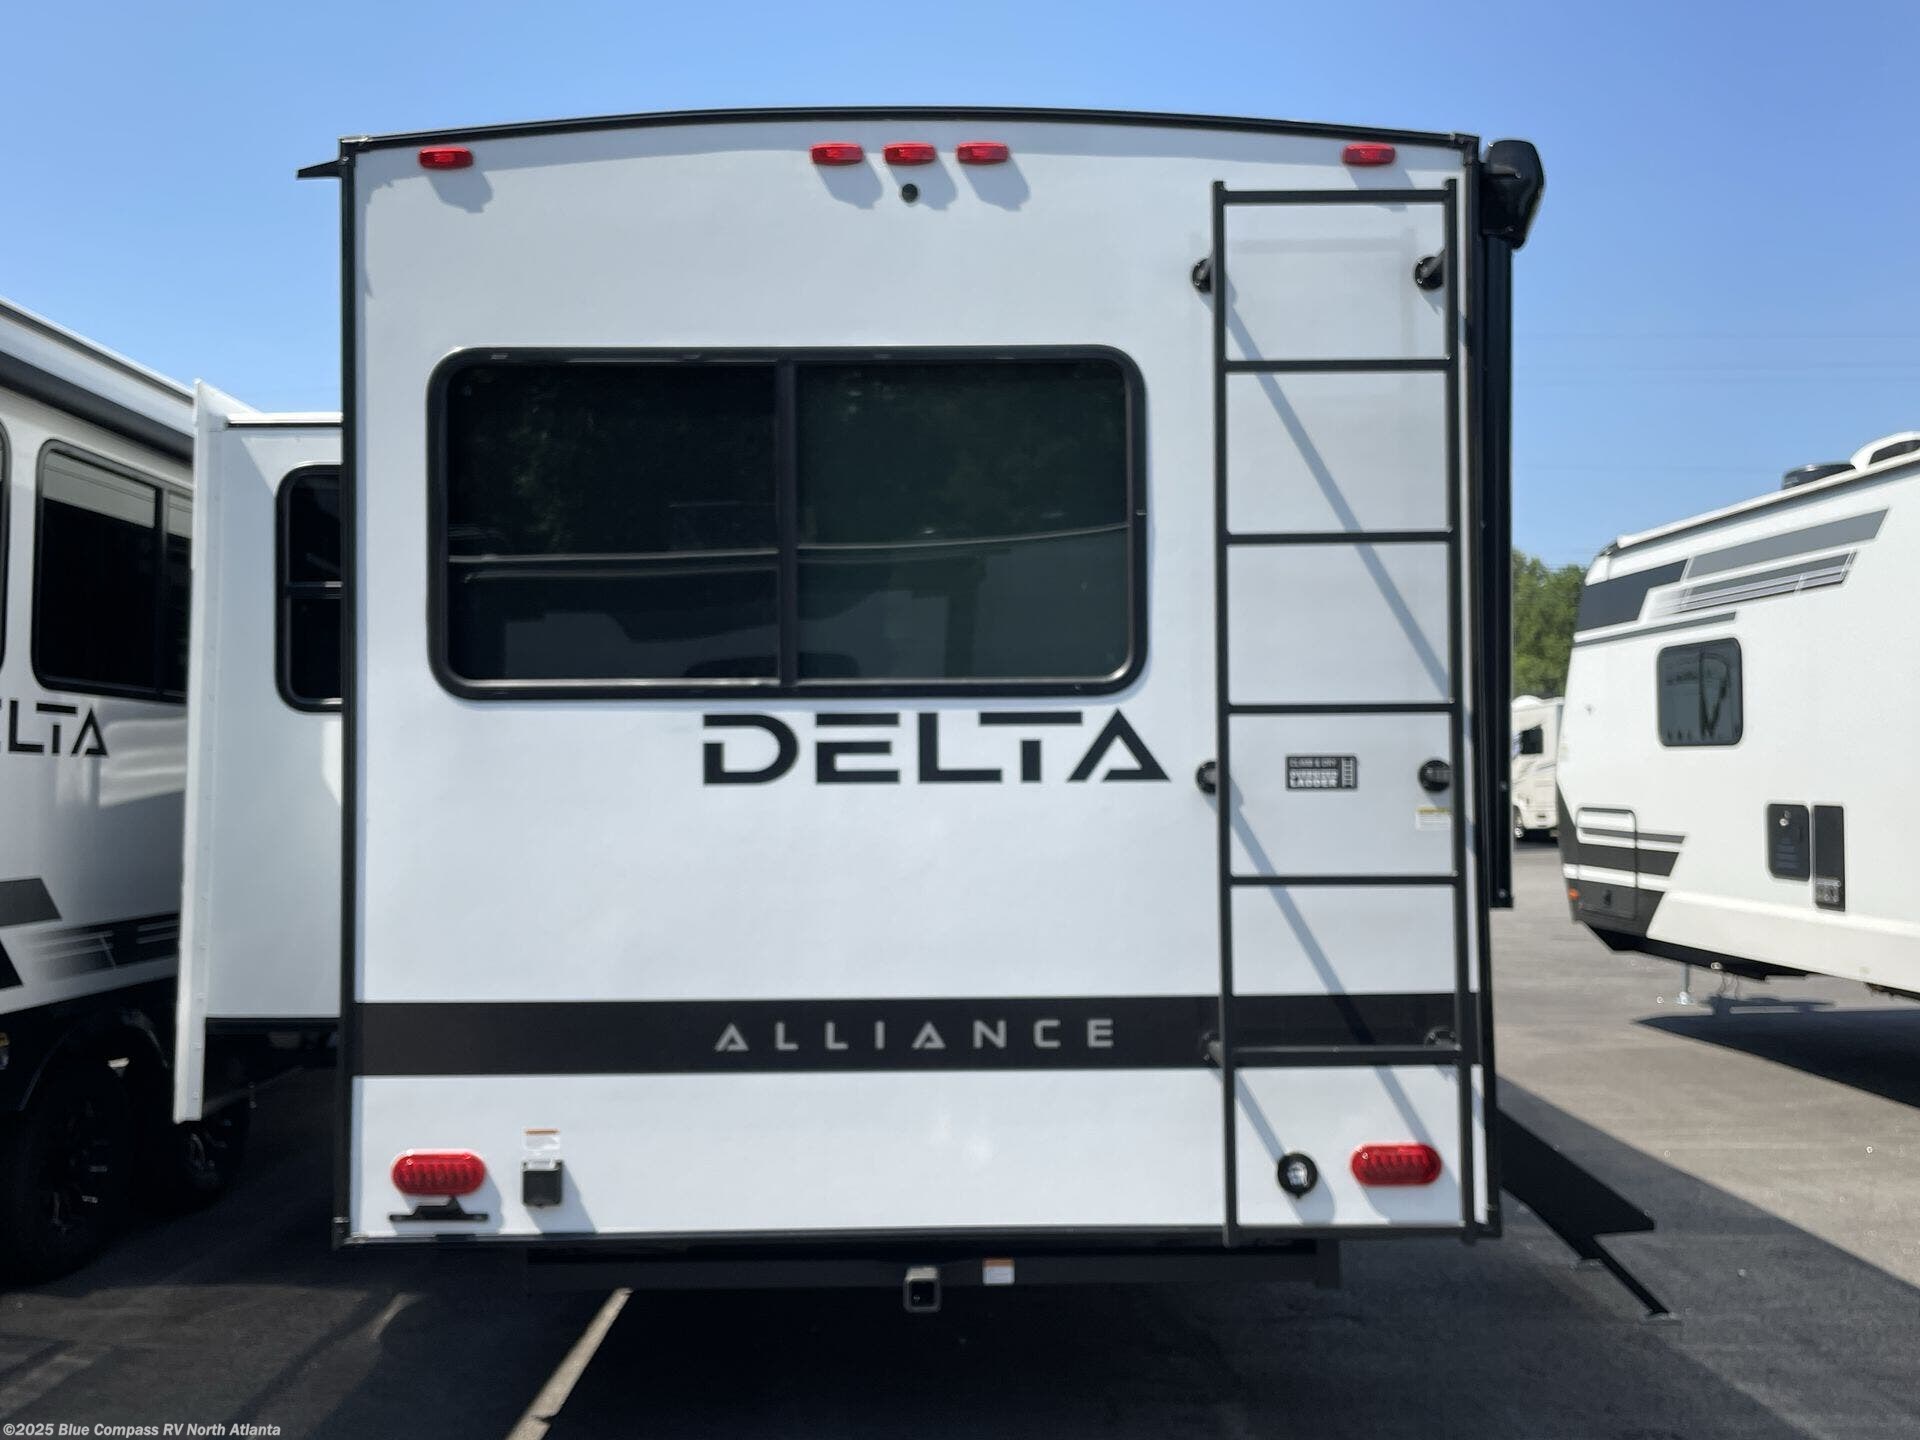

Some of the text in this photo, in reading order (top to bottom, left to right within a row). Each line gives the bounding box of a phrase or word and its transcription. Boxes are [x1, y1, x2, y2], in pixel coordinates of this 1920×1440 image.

[0, 698, 108, 756] LTA
[703, 708, 1171, 785] DELTA
[714, 1018, 1114, 1052] ALLIANCE
